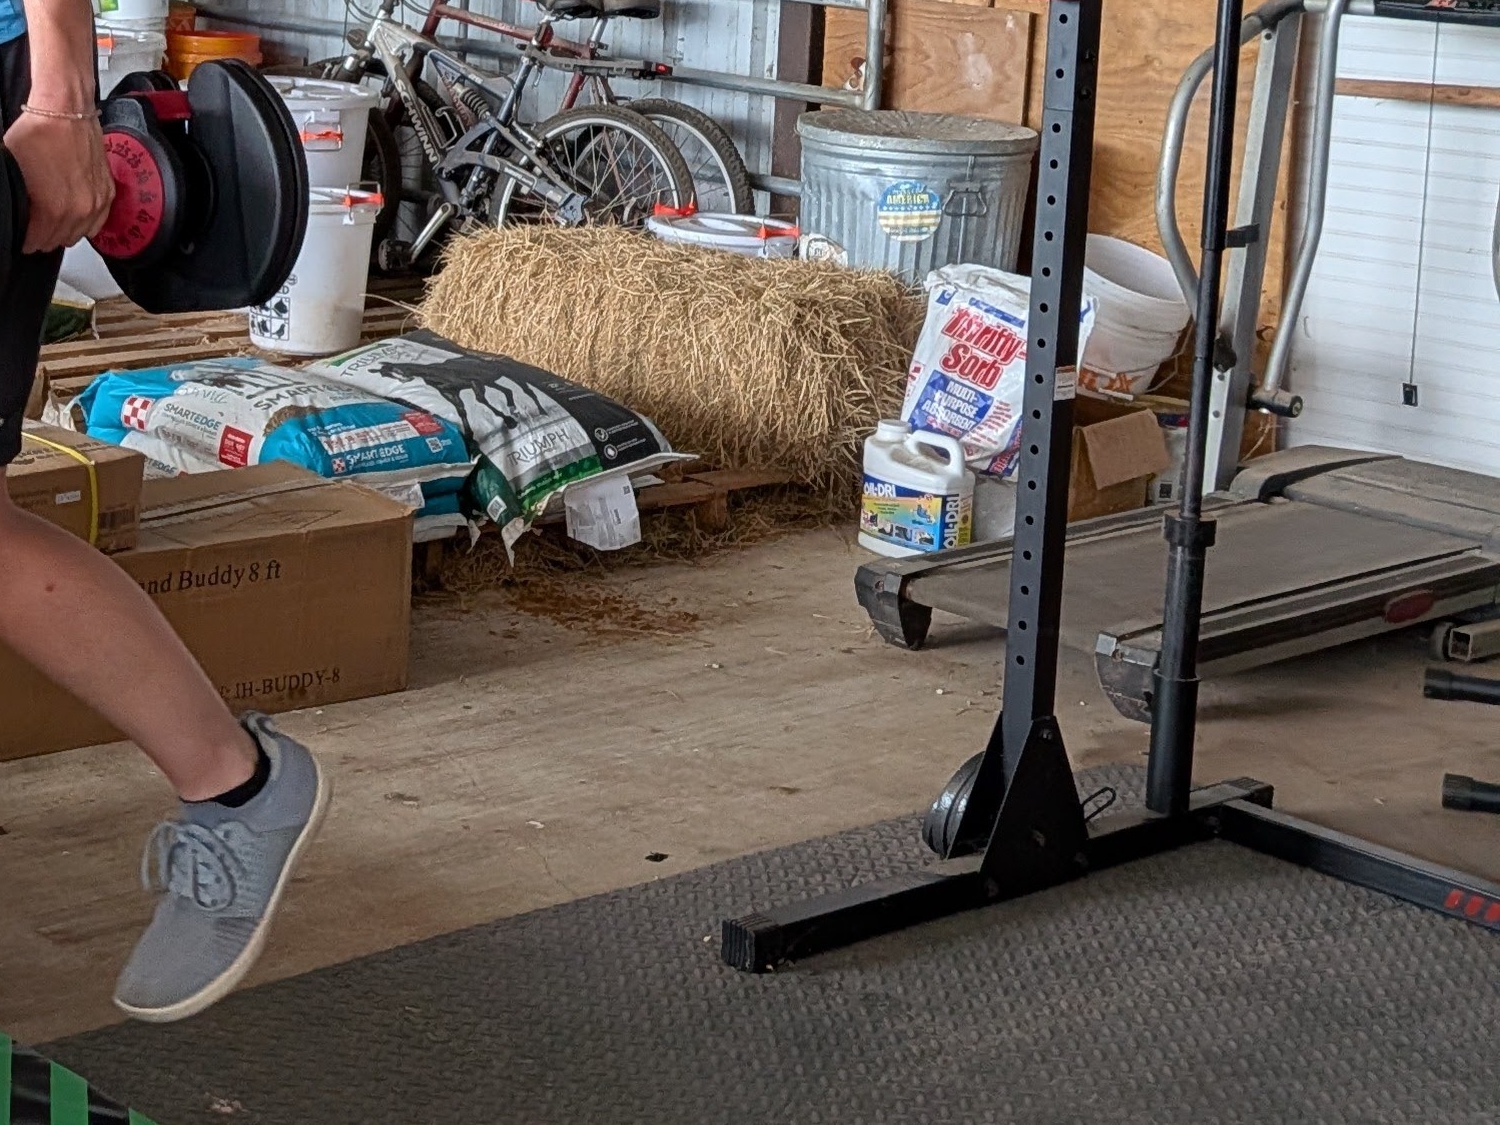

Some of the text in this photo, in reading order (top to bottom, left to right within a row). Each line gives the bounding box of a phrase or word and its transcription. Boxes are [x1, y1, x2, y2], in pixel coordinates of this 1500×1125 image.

[395, 79, 439, 164] SCHWINN
[939, 339, 1004, 390] Sorb
[163, 402, 222, 431] SMARTEDGE
[934, 390, 979, 418] PURPOSE
[506, 427, 570, 467] TRIUMPH
[177, 565, 245, 590] Buddy
[248, 562, 260, 583] 8
[264, 559, 282, 581] ft
[235, 668, 341, 700] IH-BUDDY-8
